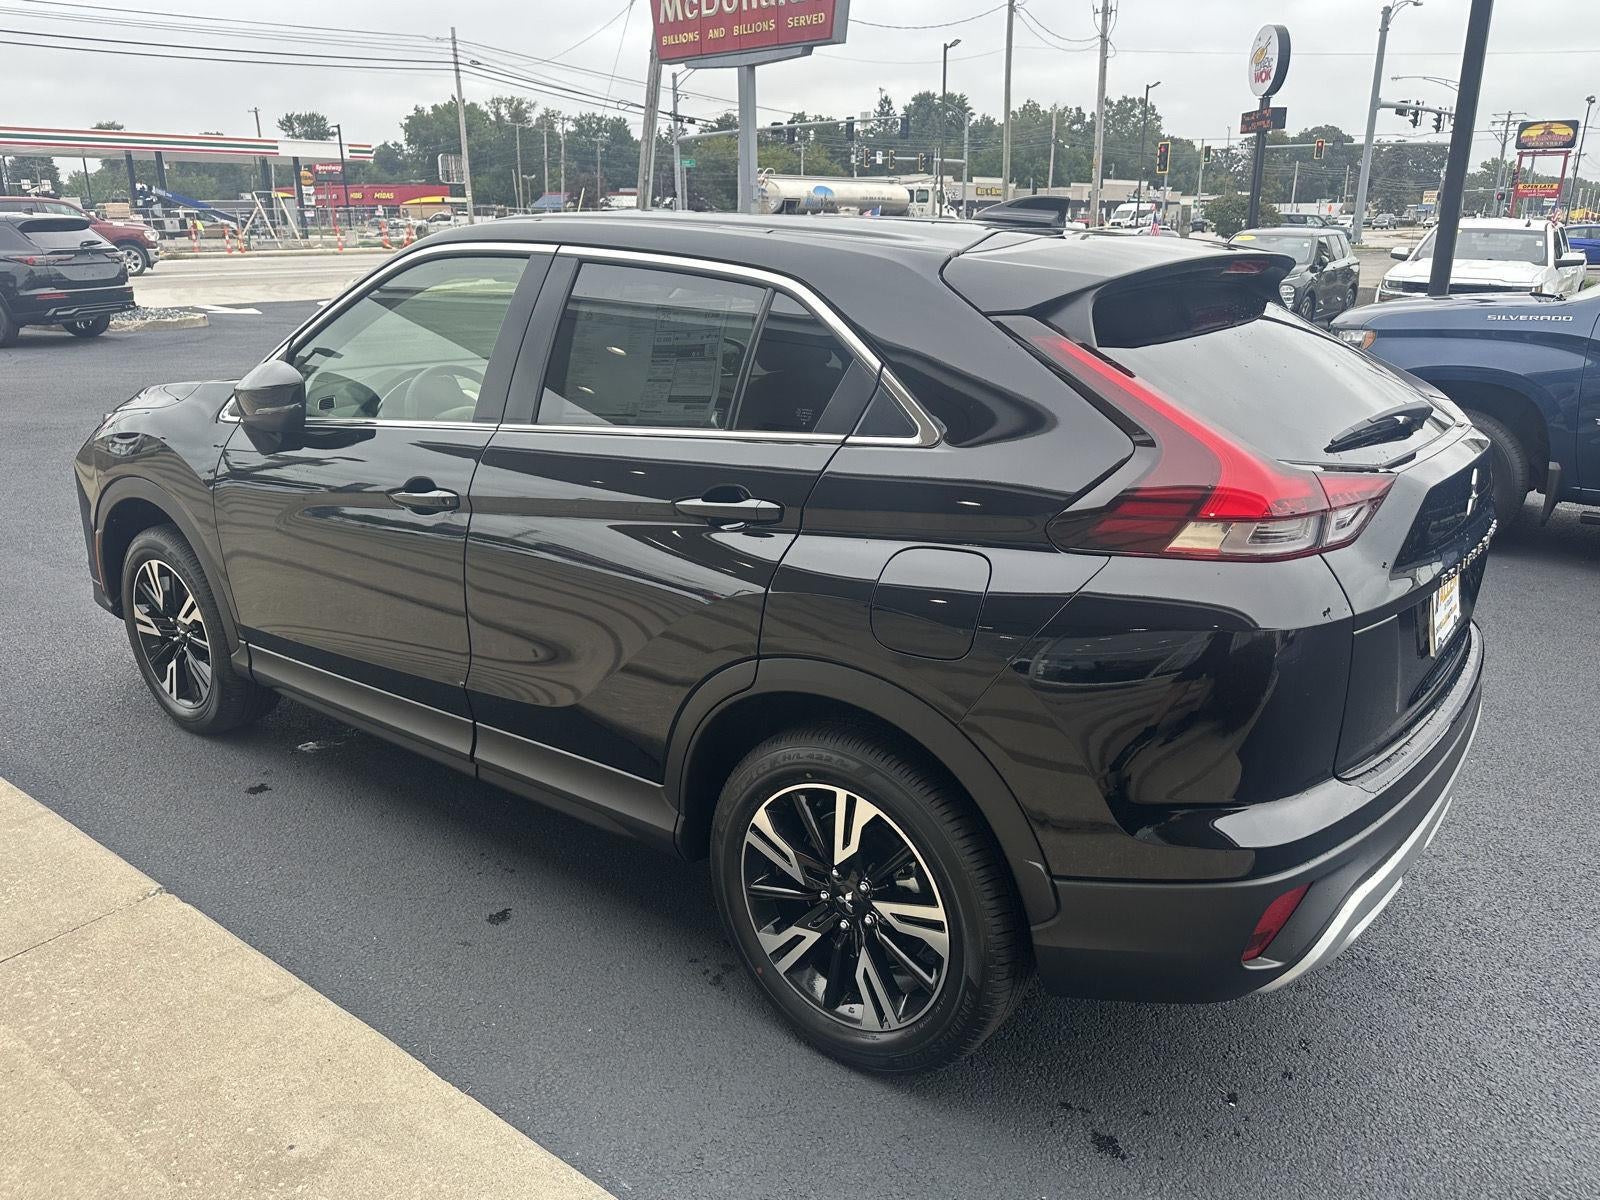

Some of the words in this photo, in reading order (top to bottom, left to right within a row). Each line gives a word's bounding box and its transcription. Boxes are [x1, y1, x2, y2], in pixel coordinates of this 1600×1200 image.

[662, 31, 700, 46] BILLIONS
[707, 27, 726, 40] AND
[733, 19, 776, 36] BILLIONS
[787, 12, 826, 28] SERVED
[1254, 69, 1272, 84] WOK
[315, 164, 342, 172] Speedway
[1486, 314, 1573, 322] SILVERADO
